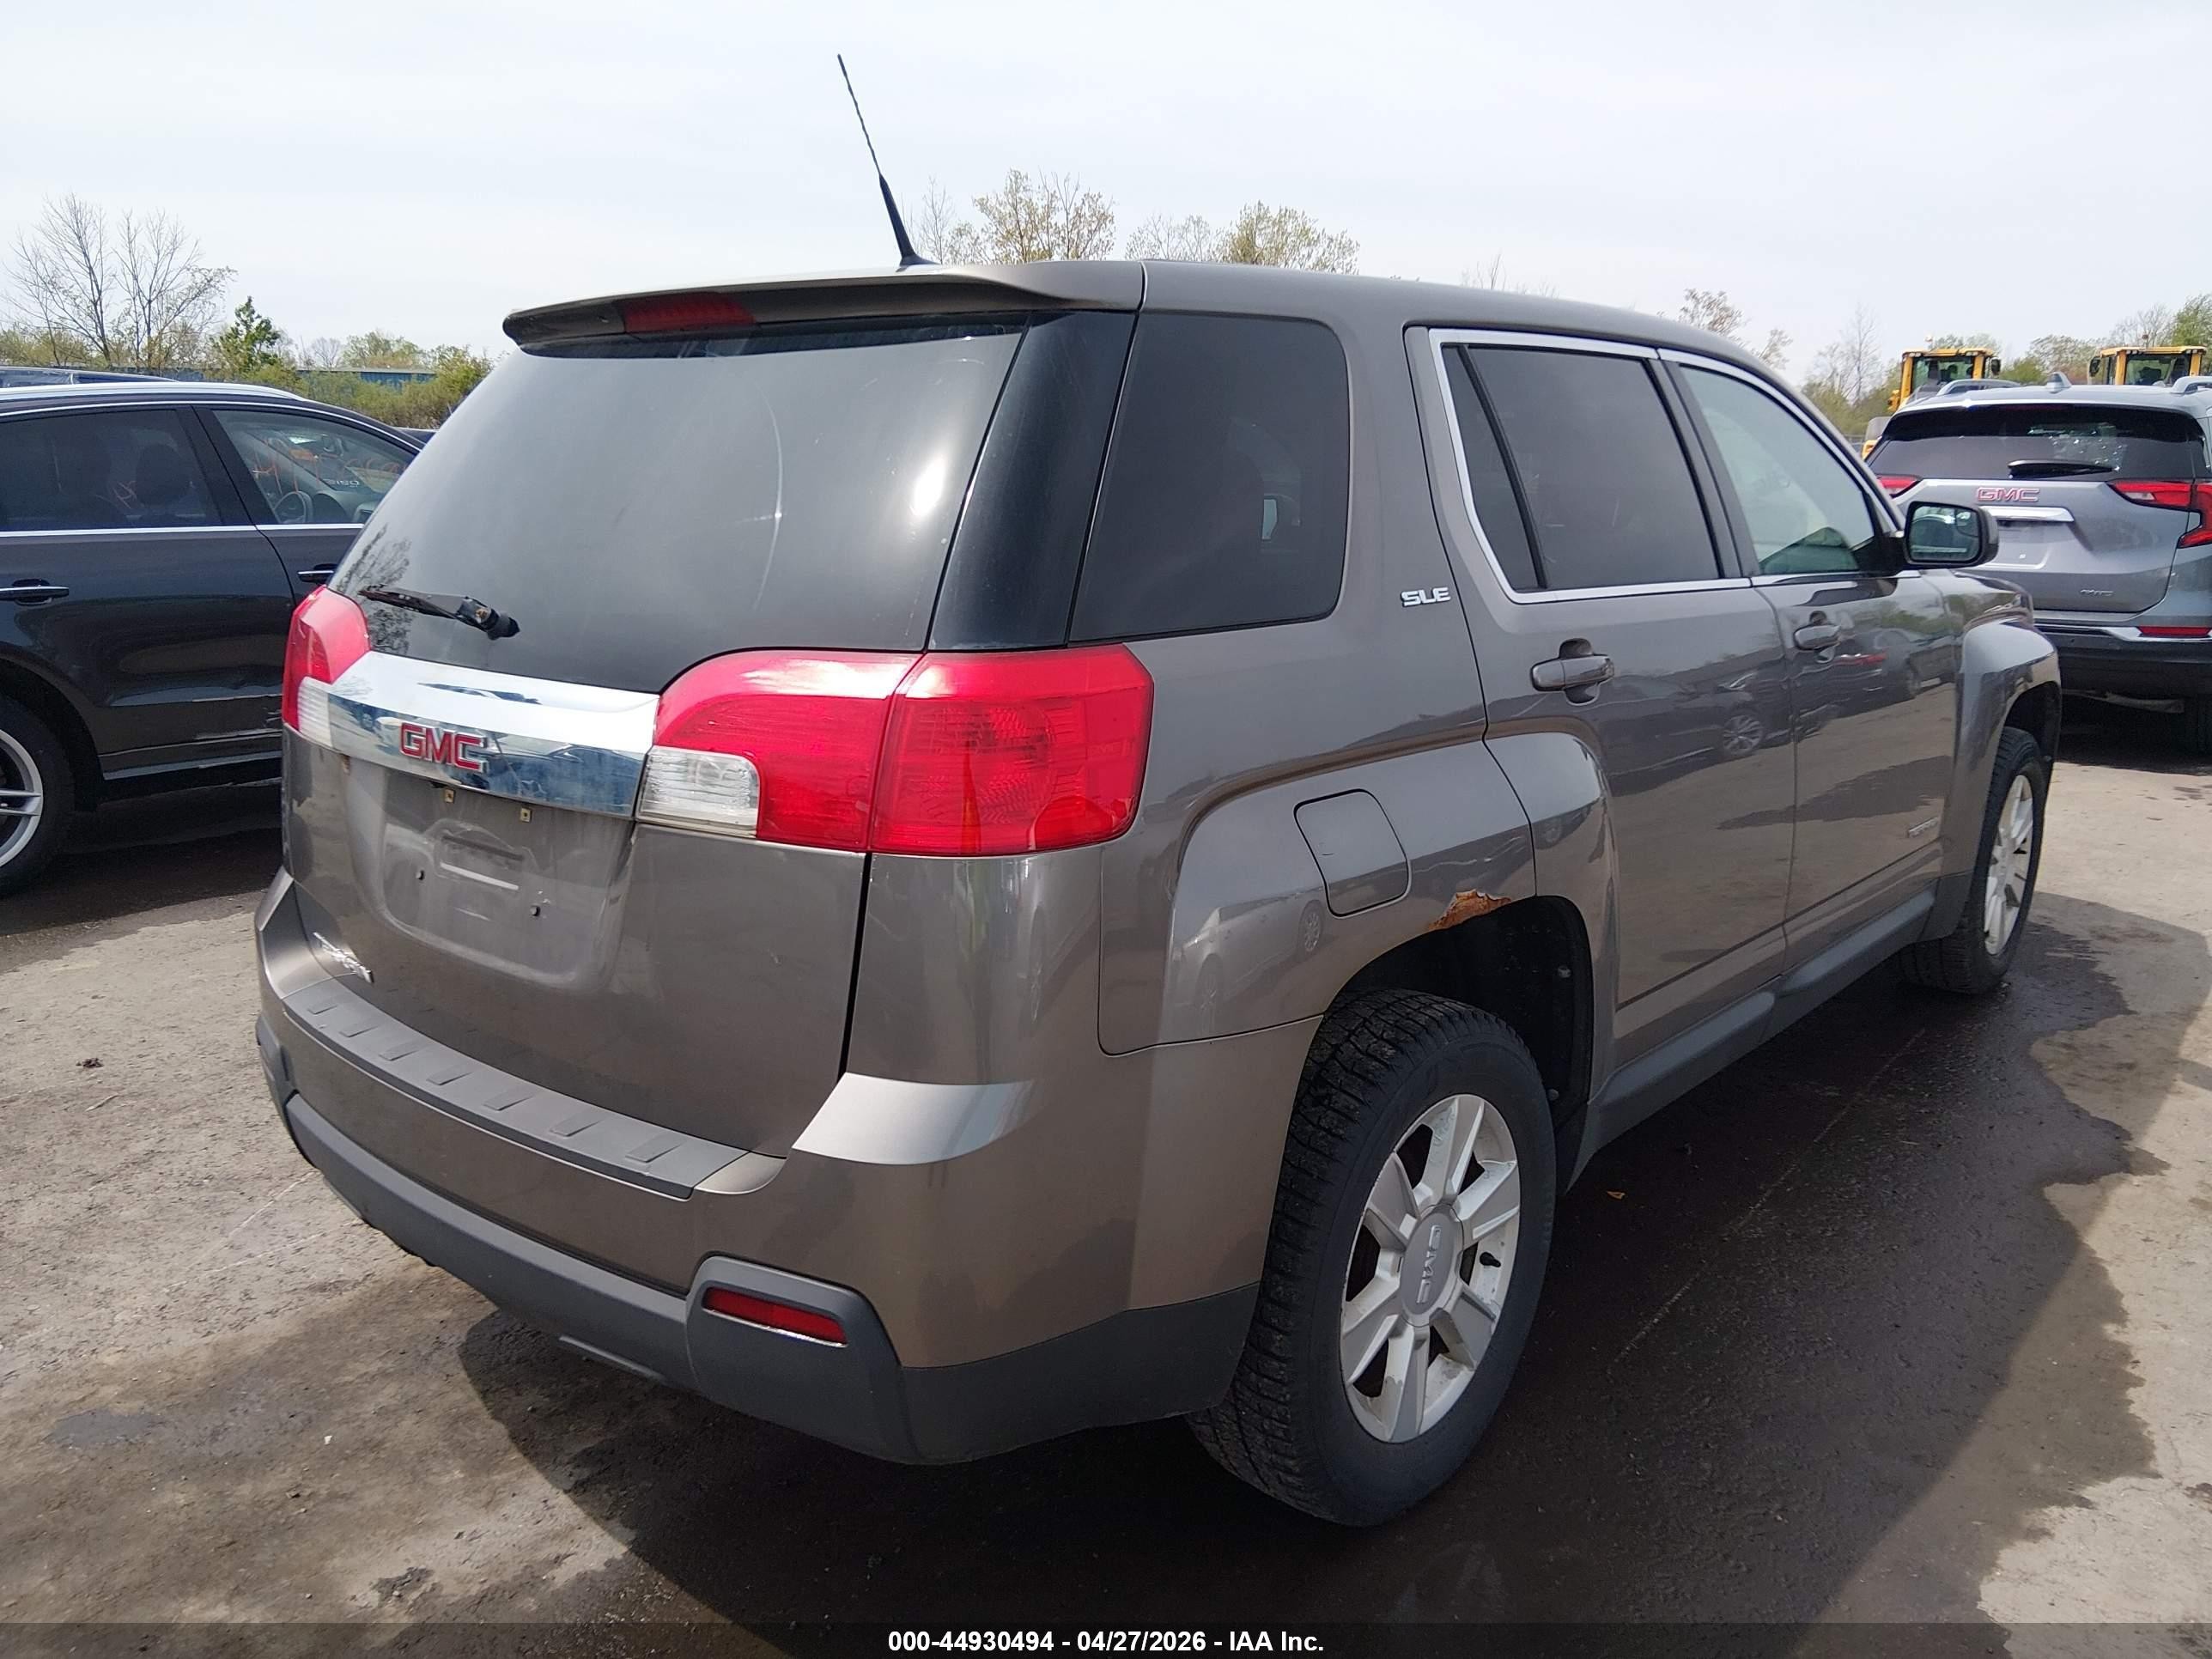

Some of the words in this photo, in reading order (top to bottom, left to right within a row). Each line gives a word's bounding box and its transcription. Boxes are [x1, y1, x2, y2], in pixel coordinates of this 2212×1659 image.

[1978, 487, 2040, 502] GMC
[1401, 586, 1451, 607] SLE
[399, 721, 488, 773] GMC
[1416, 1224, 1442, 1304] GMC
